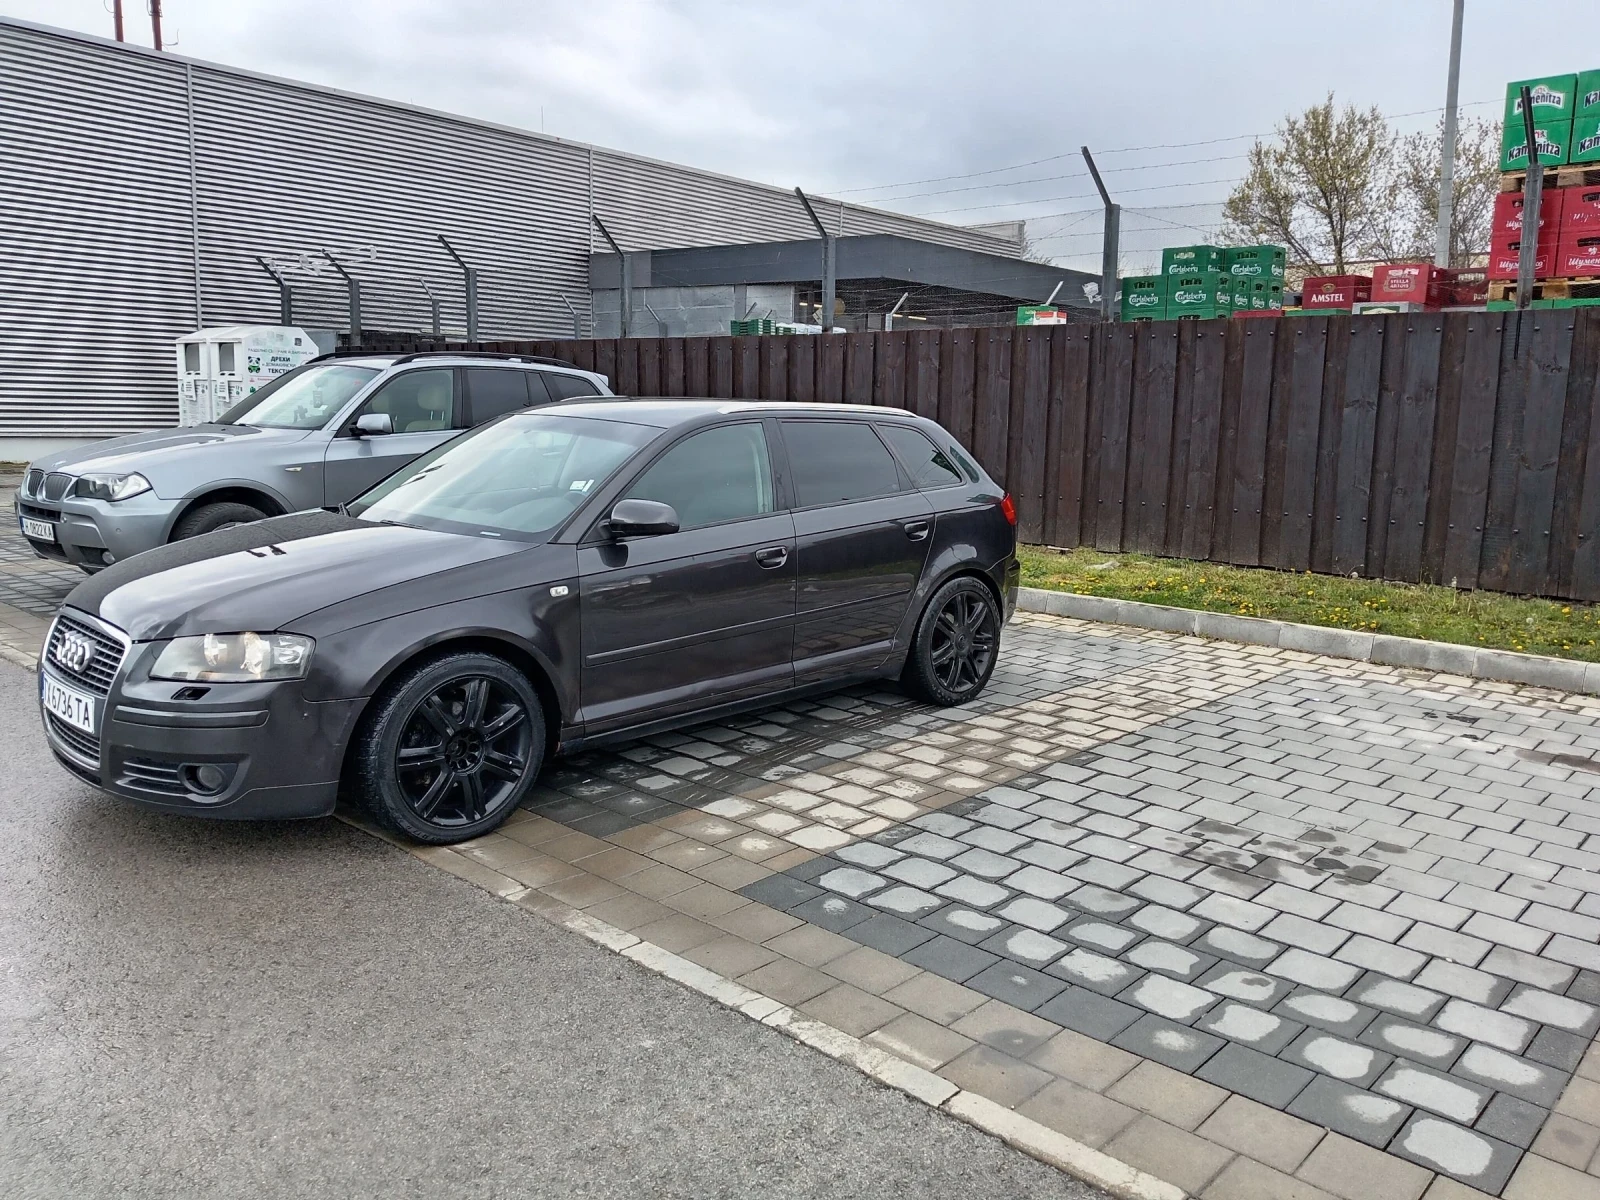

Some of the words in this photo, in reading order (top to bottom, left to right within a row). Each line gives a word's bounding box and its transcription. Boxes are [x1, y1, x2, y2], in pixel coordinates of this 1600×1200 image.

[1508, 142, 1560, 162] Kamnitza
[1169, 264, 1199, 275] Carlsberg
[1231, 263, 1262, 275] Carlsberg
[1129, 293, 1159, 307] Carlsberg
[1175, 290, 1206, 304] Carlsberg
[1311, 293, 1345, 303] AMSTEL
[52, 685, 73, 719] 6736
[75, 697, 91, 728] TA
